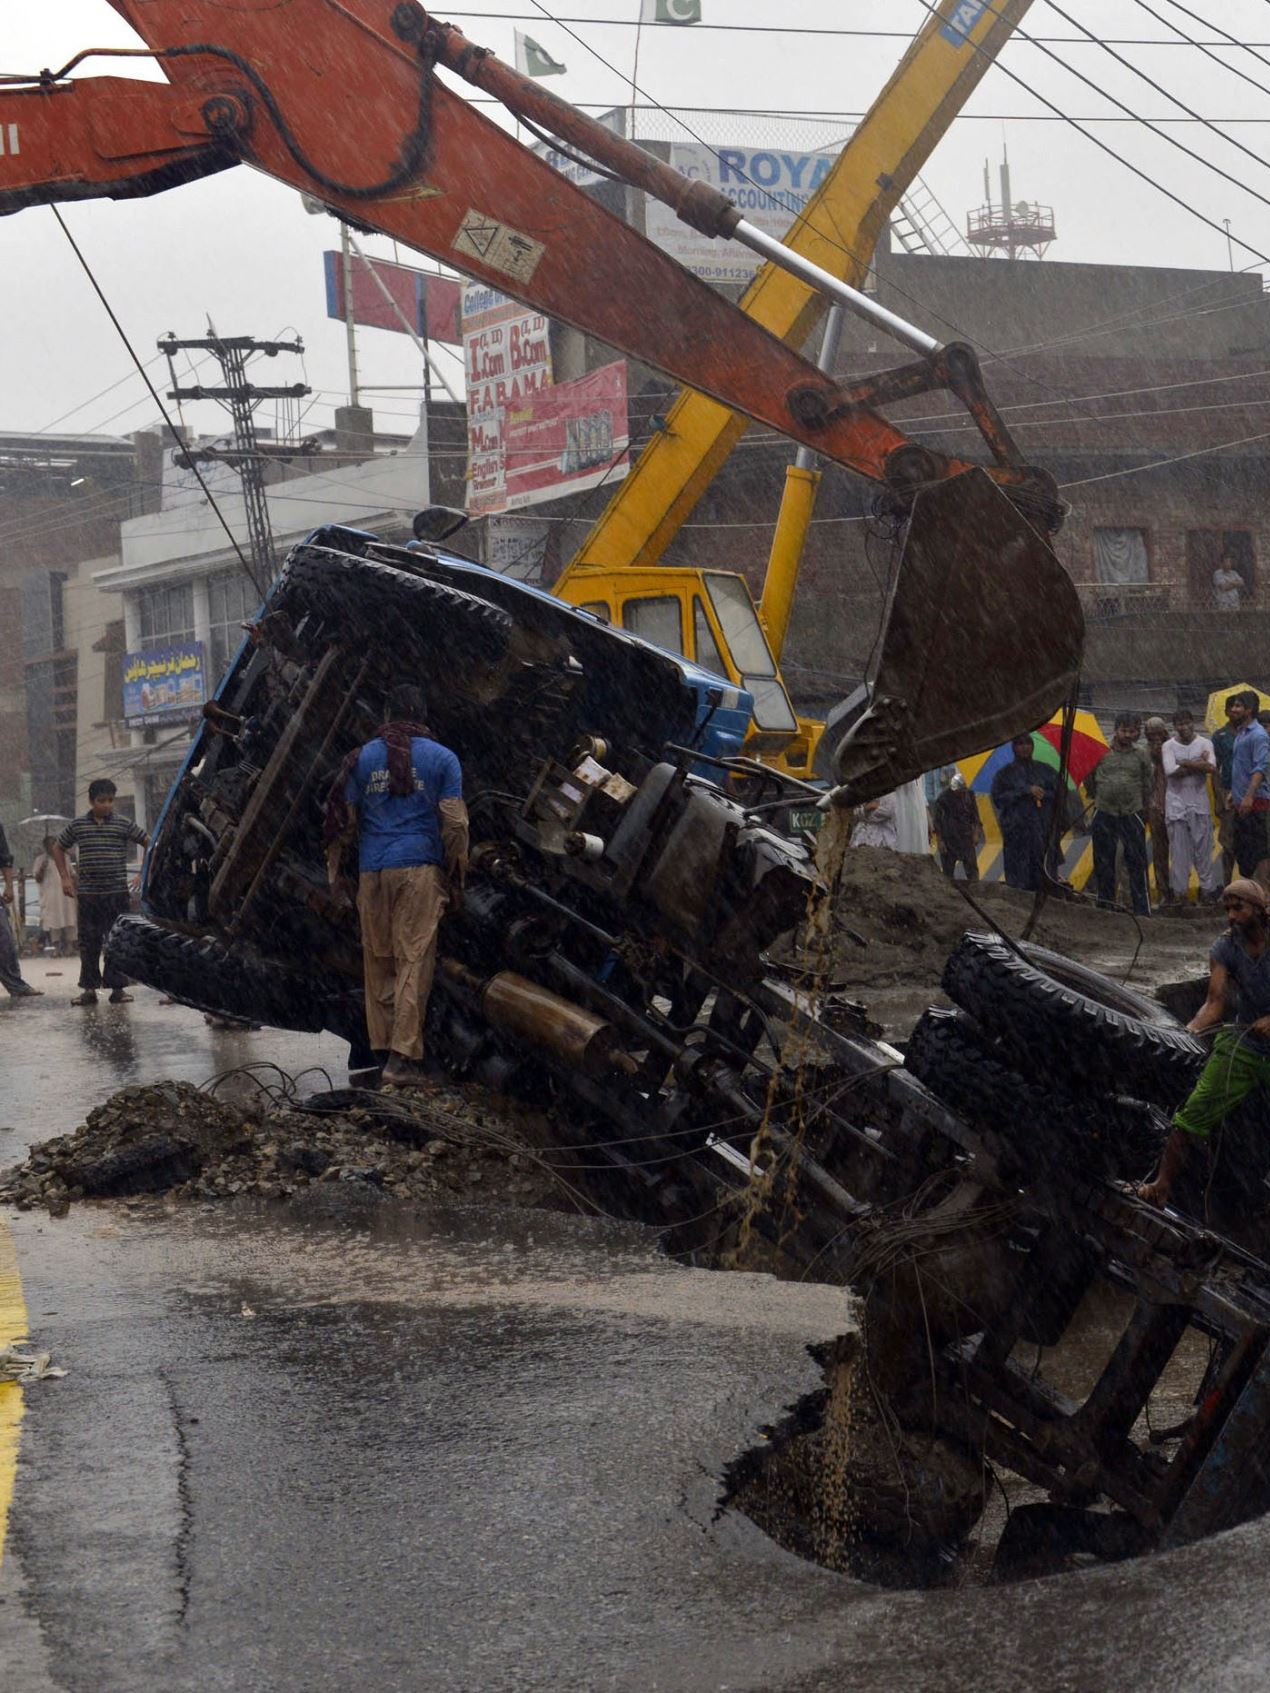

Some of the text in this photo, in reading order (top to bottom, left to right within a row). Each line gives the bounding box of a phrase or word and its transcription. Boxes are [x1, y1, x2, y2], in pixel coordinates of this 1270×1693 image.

[718, 150, 833, 189] ROYA
[721, 188, 808, 213] CCOUNTIN
[464, 290, 494, 314] College
[510, 324, 547, 371] B.Com
[371, 767, 417, 781] DRAE
